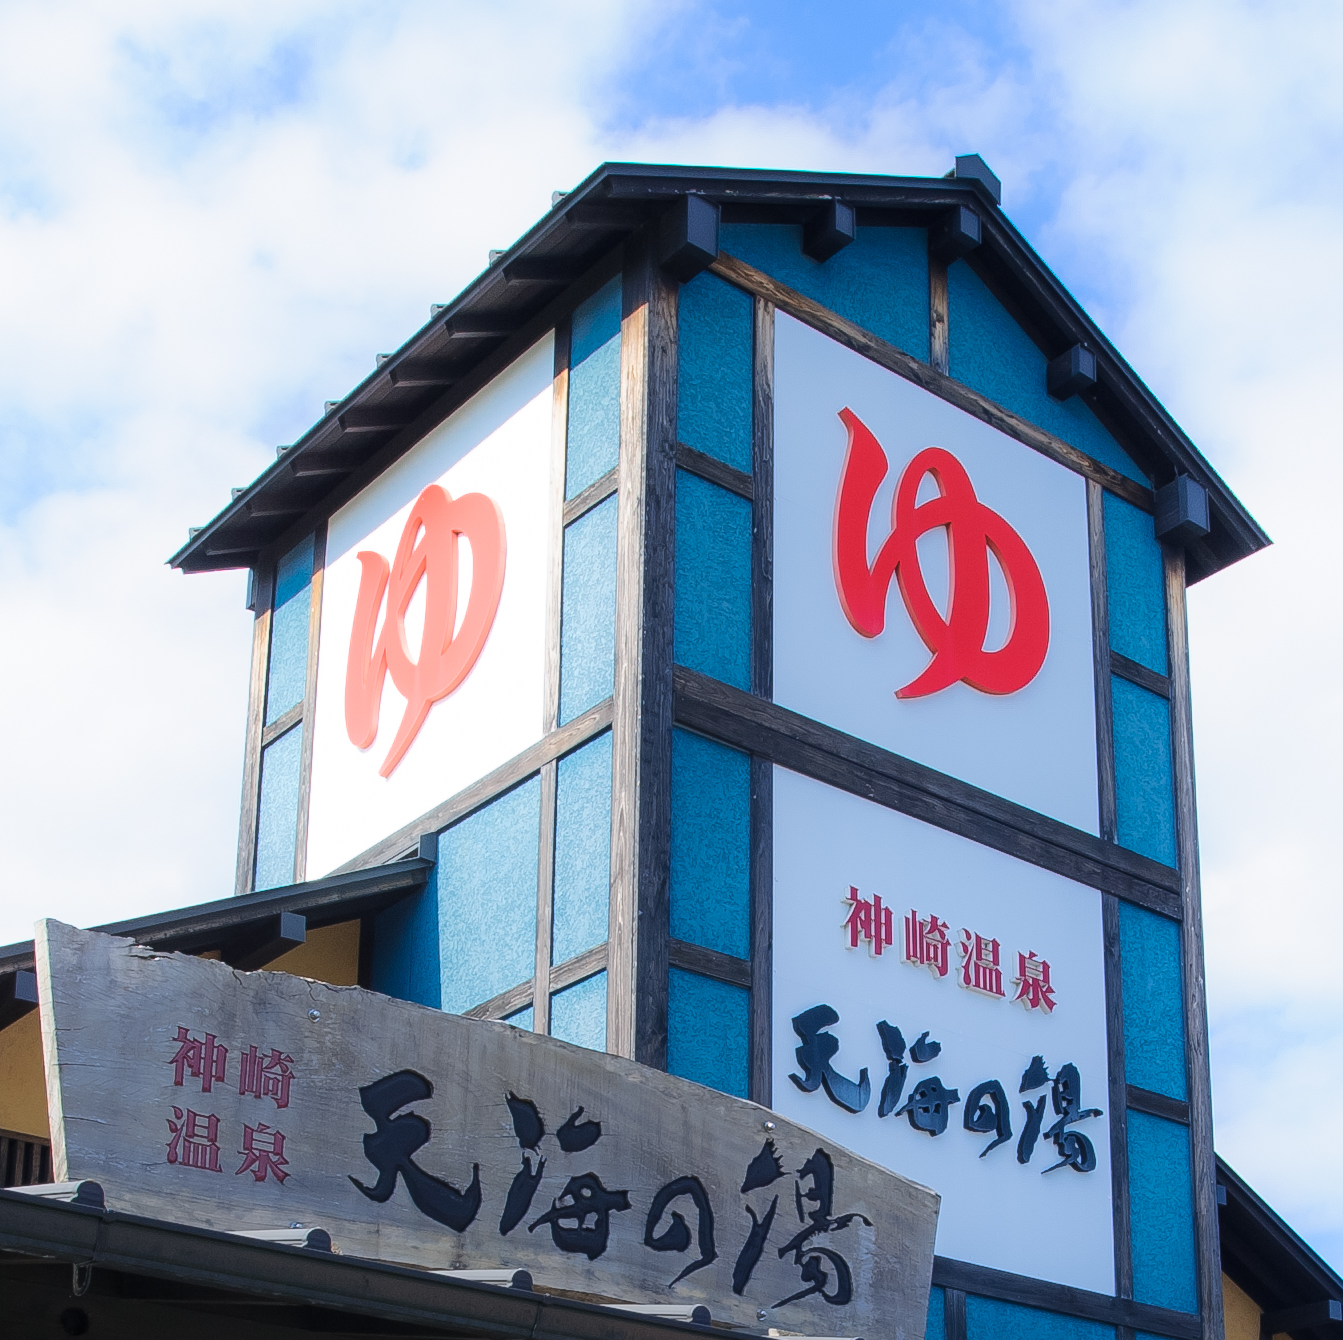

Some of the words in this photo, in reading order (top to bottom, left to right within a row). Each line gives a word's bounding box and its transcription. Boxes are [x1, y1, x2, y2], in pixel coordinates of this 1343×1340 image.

[344, 483, 508, 779] ゆ
[833, 405, 1051, 701] ゆ
[841, 884, 1058, 1014] 神崎温泉
[166, 1105, 291, 1184] 温泉
[168, 1025, 297, 1112] 神崎
[787, 1004, 1104, 1174] 天海の湯
[348, 1068, 874, 1309] 天海の湯
